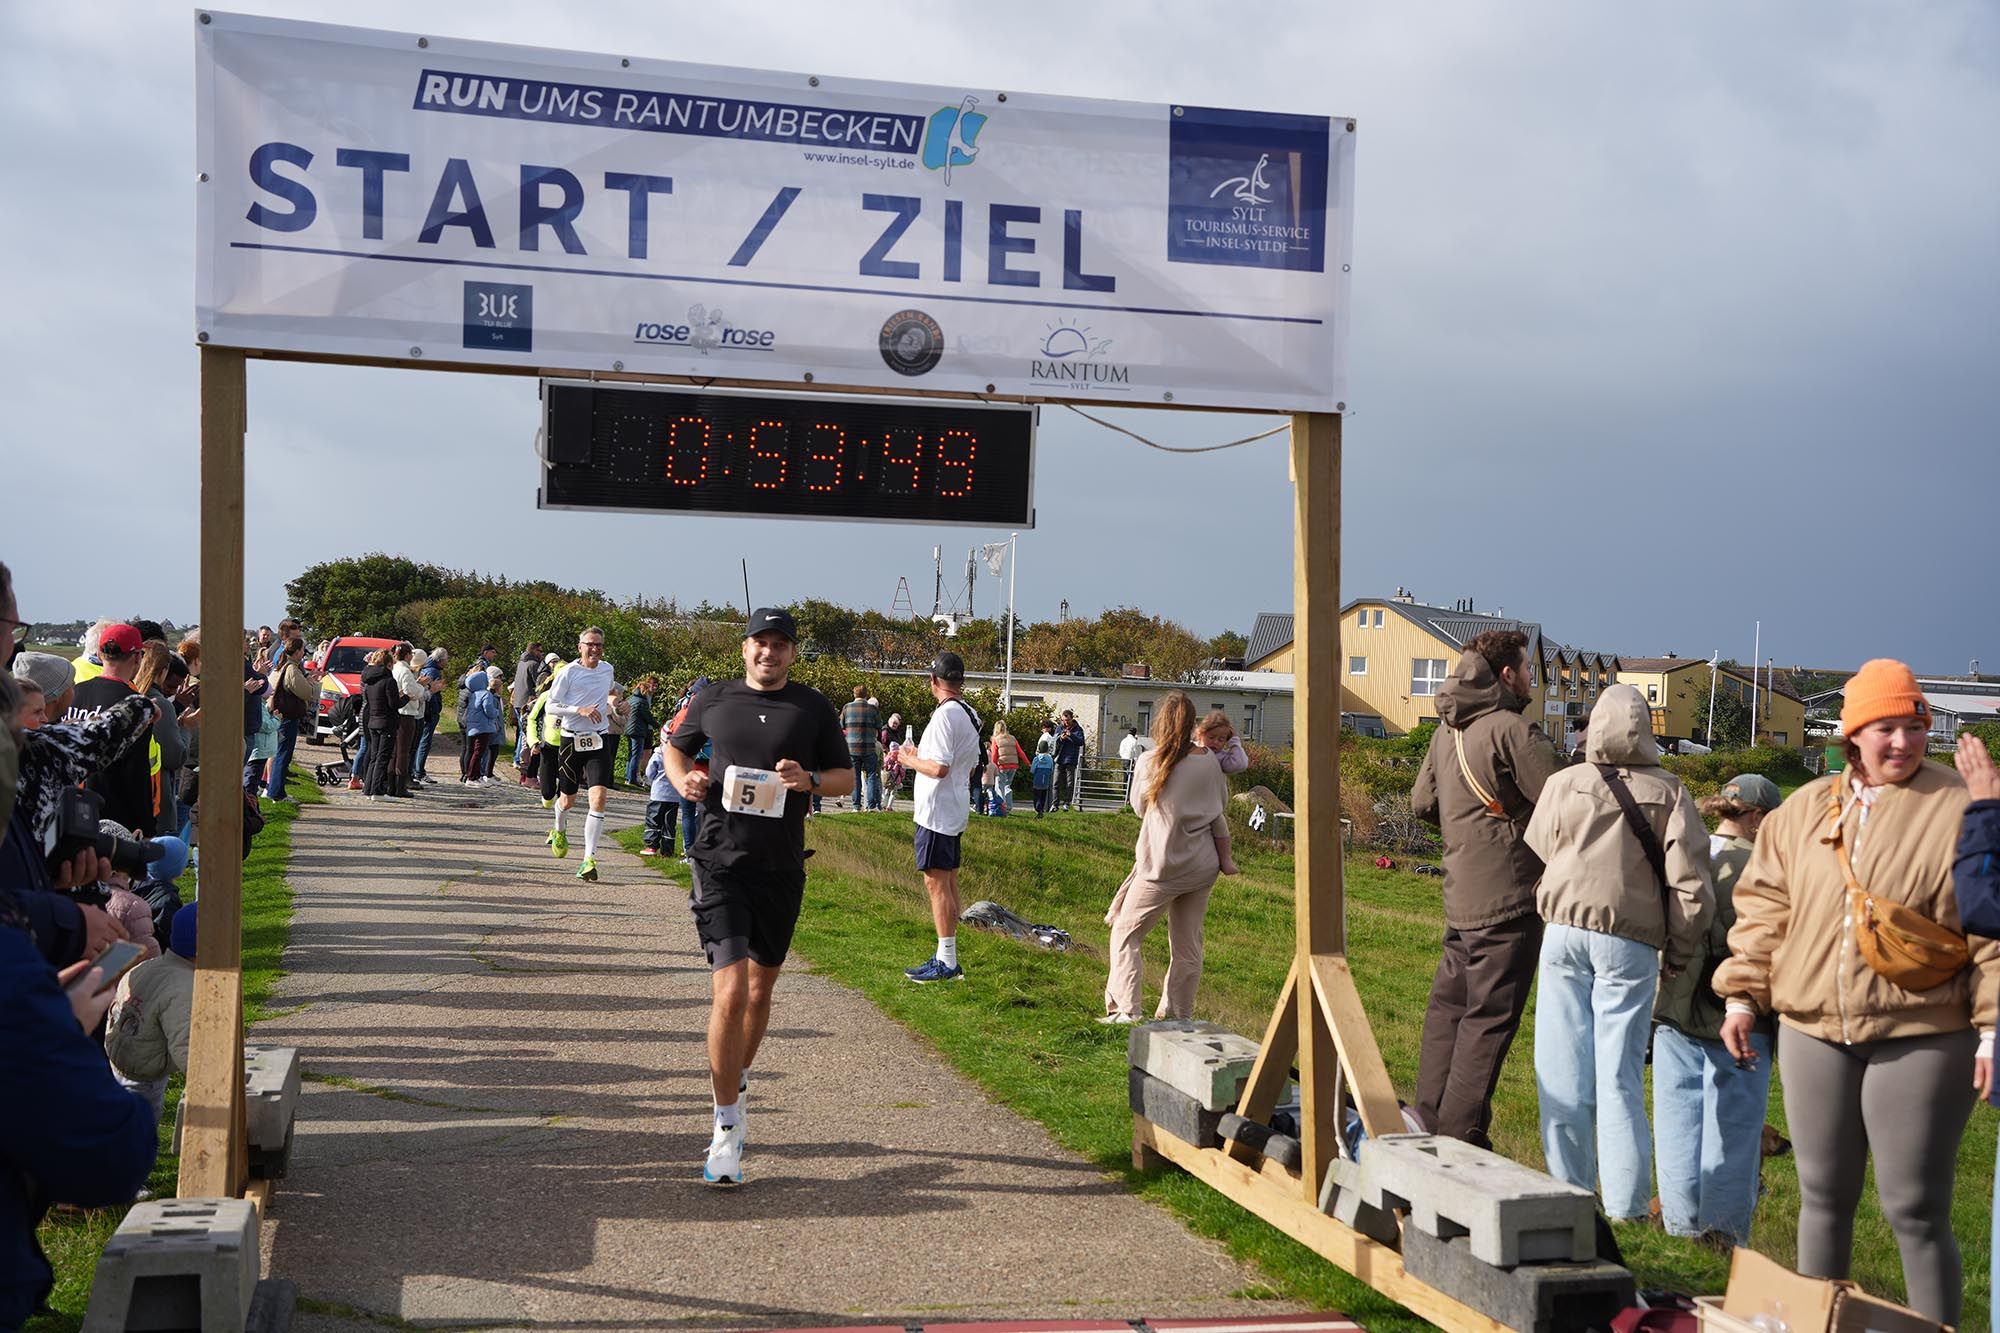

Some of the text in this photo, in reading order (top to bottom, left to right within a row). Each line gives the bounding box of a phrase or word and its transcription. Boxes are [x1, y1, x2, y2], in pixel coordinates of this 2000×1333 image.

[421, 74, 918, 147] RUN UMS RANTUMBECKEN
[803, 152, 915, 170] www.insel-sylt.de
[245, 141, 1116, 293] START / ZIEL
[1232, 207, 1266, 221] SYLT
[1184, 219, 1310, 239] TOURISMUS-SERVICE
[1206, 236, 1288, 253] INSEL-SYLT.DE
[635, 322, 775, 346] rose rose
[1031, 360, 1129, 383] RANTUM
[667, 416, 977, 497] 0:53:49
[580, 737, 593, 748] 68
[741, 784, 756, 806] 5
